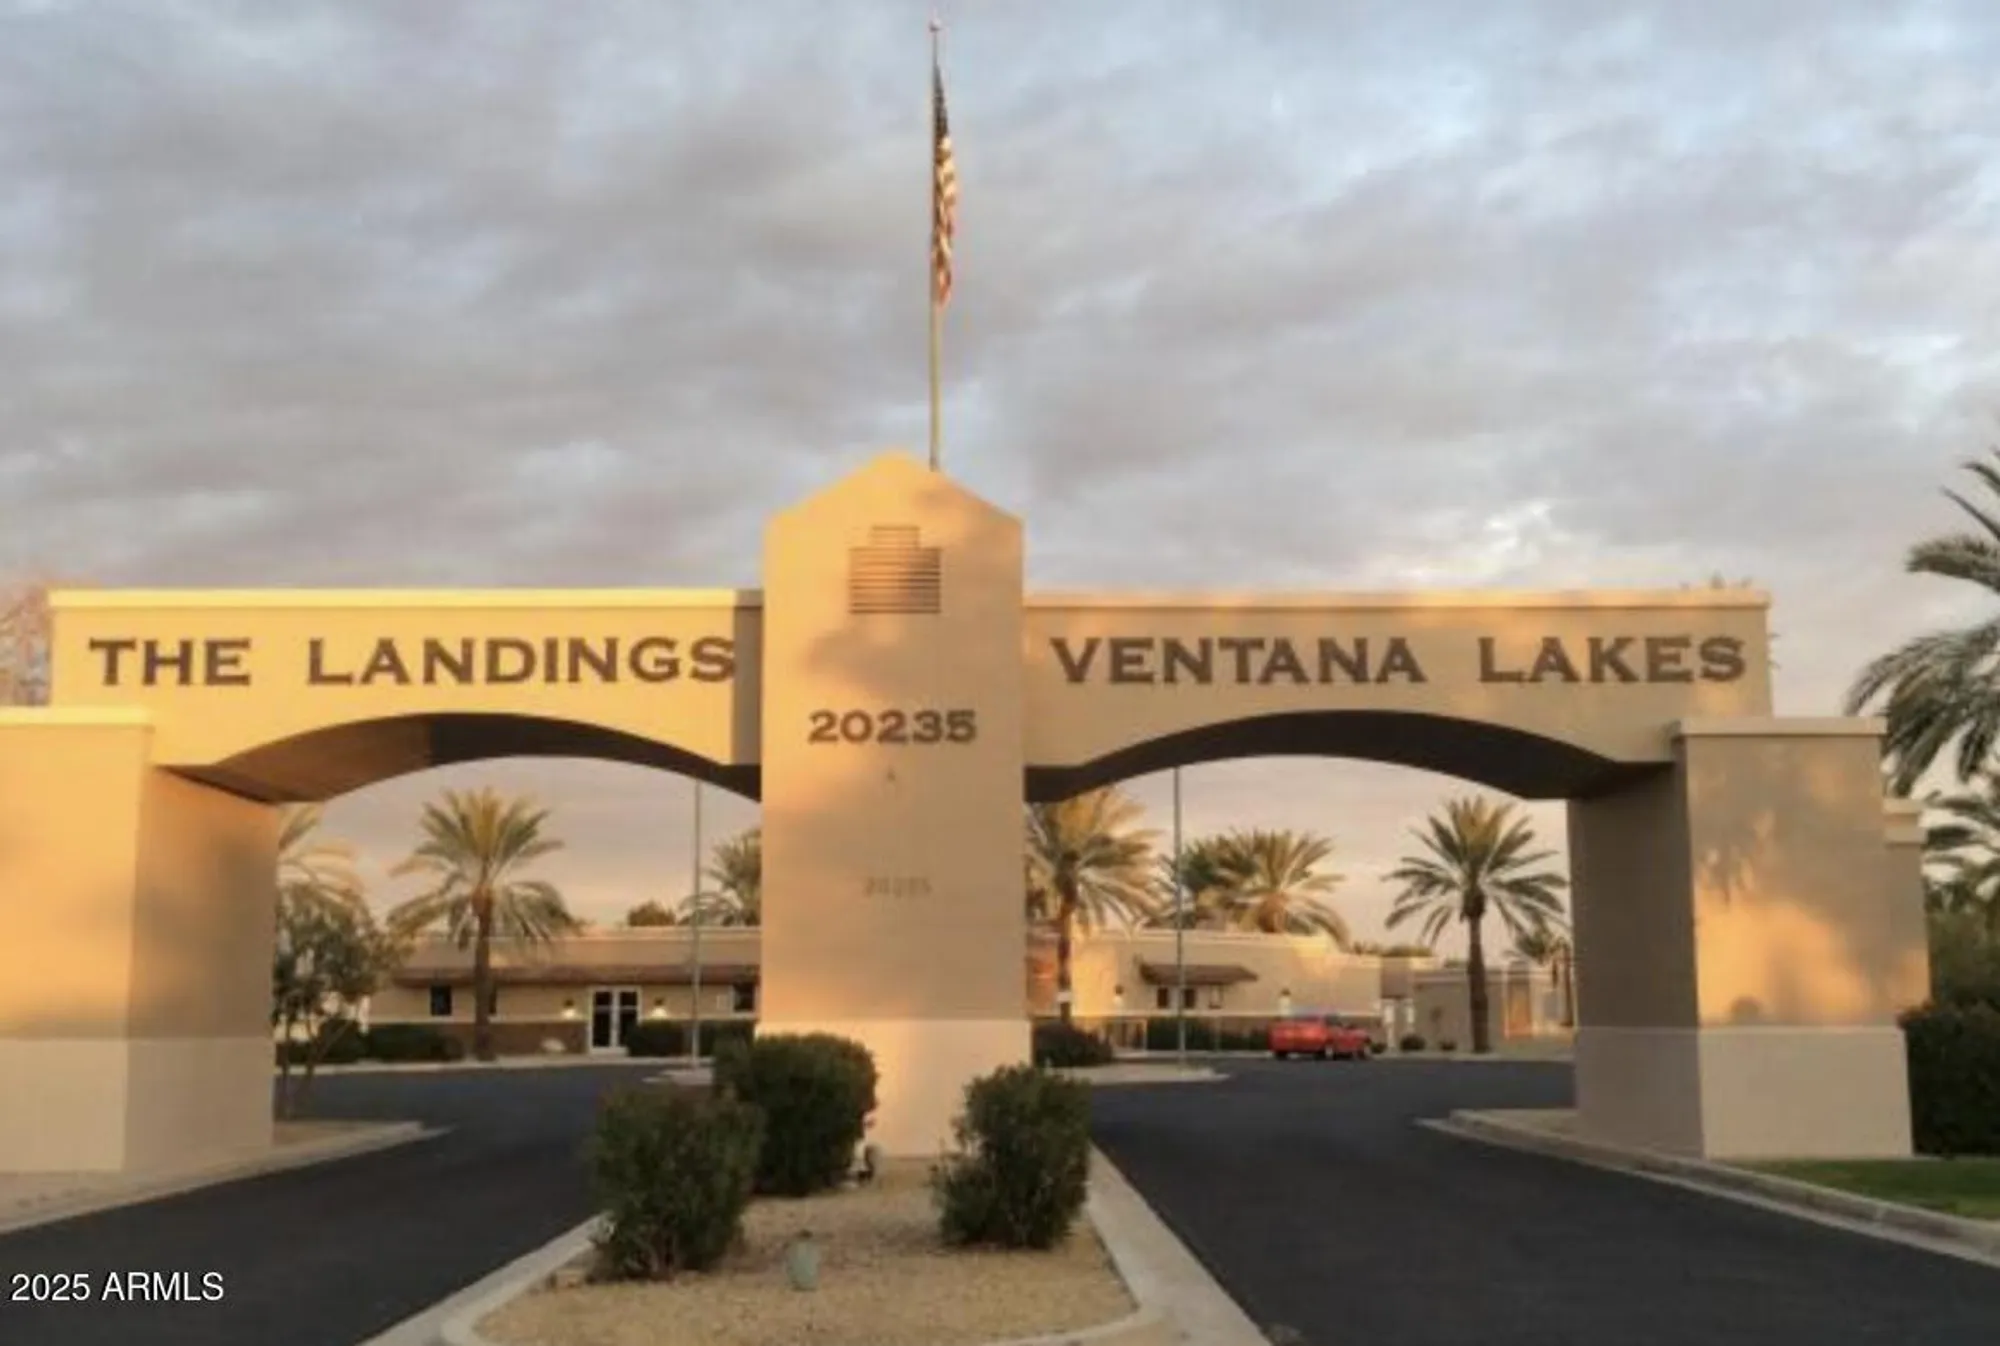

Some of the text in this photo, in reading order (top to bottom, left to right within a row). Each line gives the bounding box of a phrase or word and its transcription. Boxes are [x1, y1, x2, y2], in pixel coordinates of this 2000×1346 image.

[90, 636, 737, 686] THE LANDINGS
[1050, 636, 1746, 684] VENTANA LAKES
[807, 709, 977, 745] 20235
